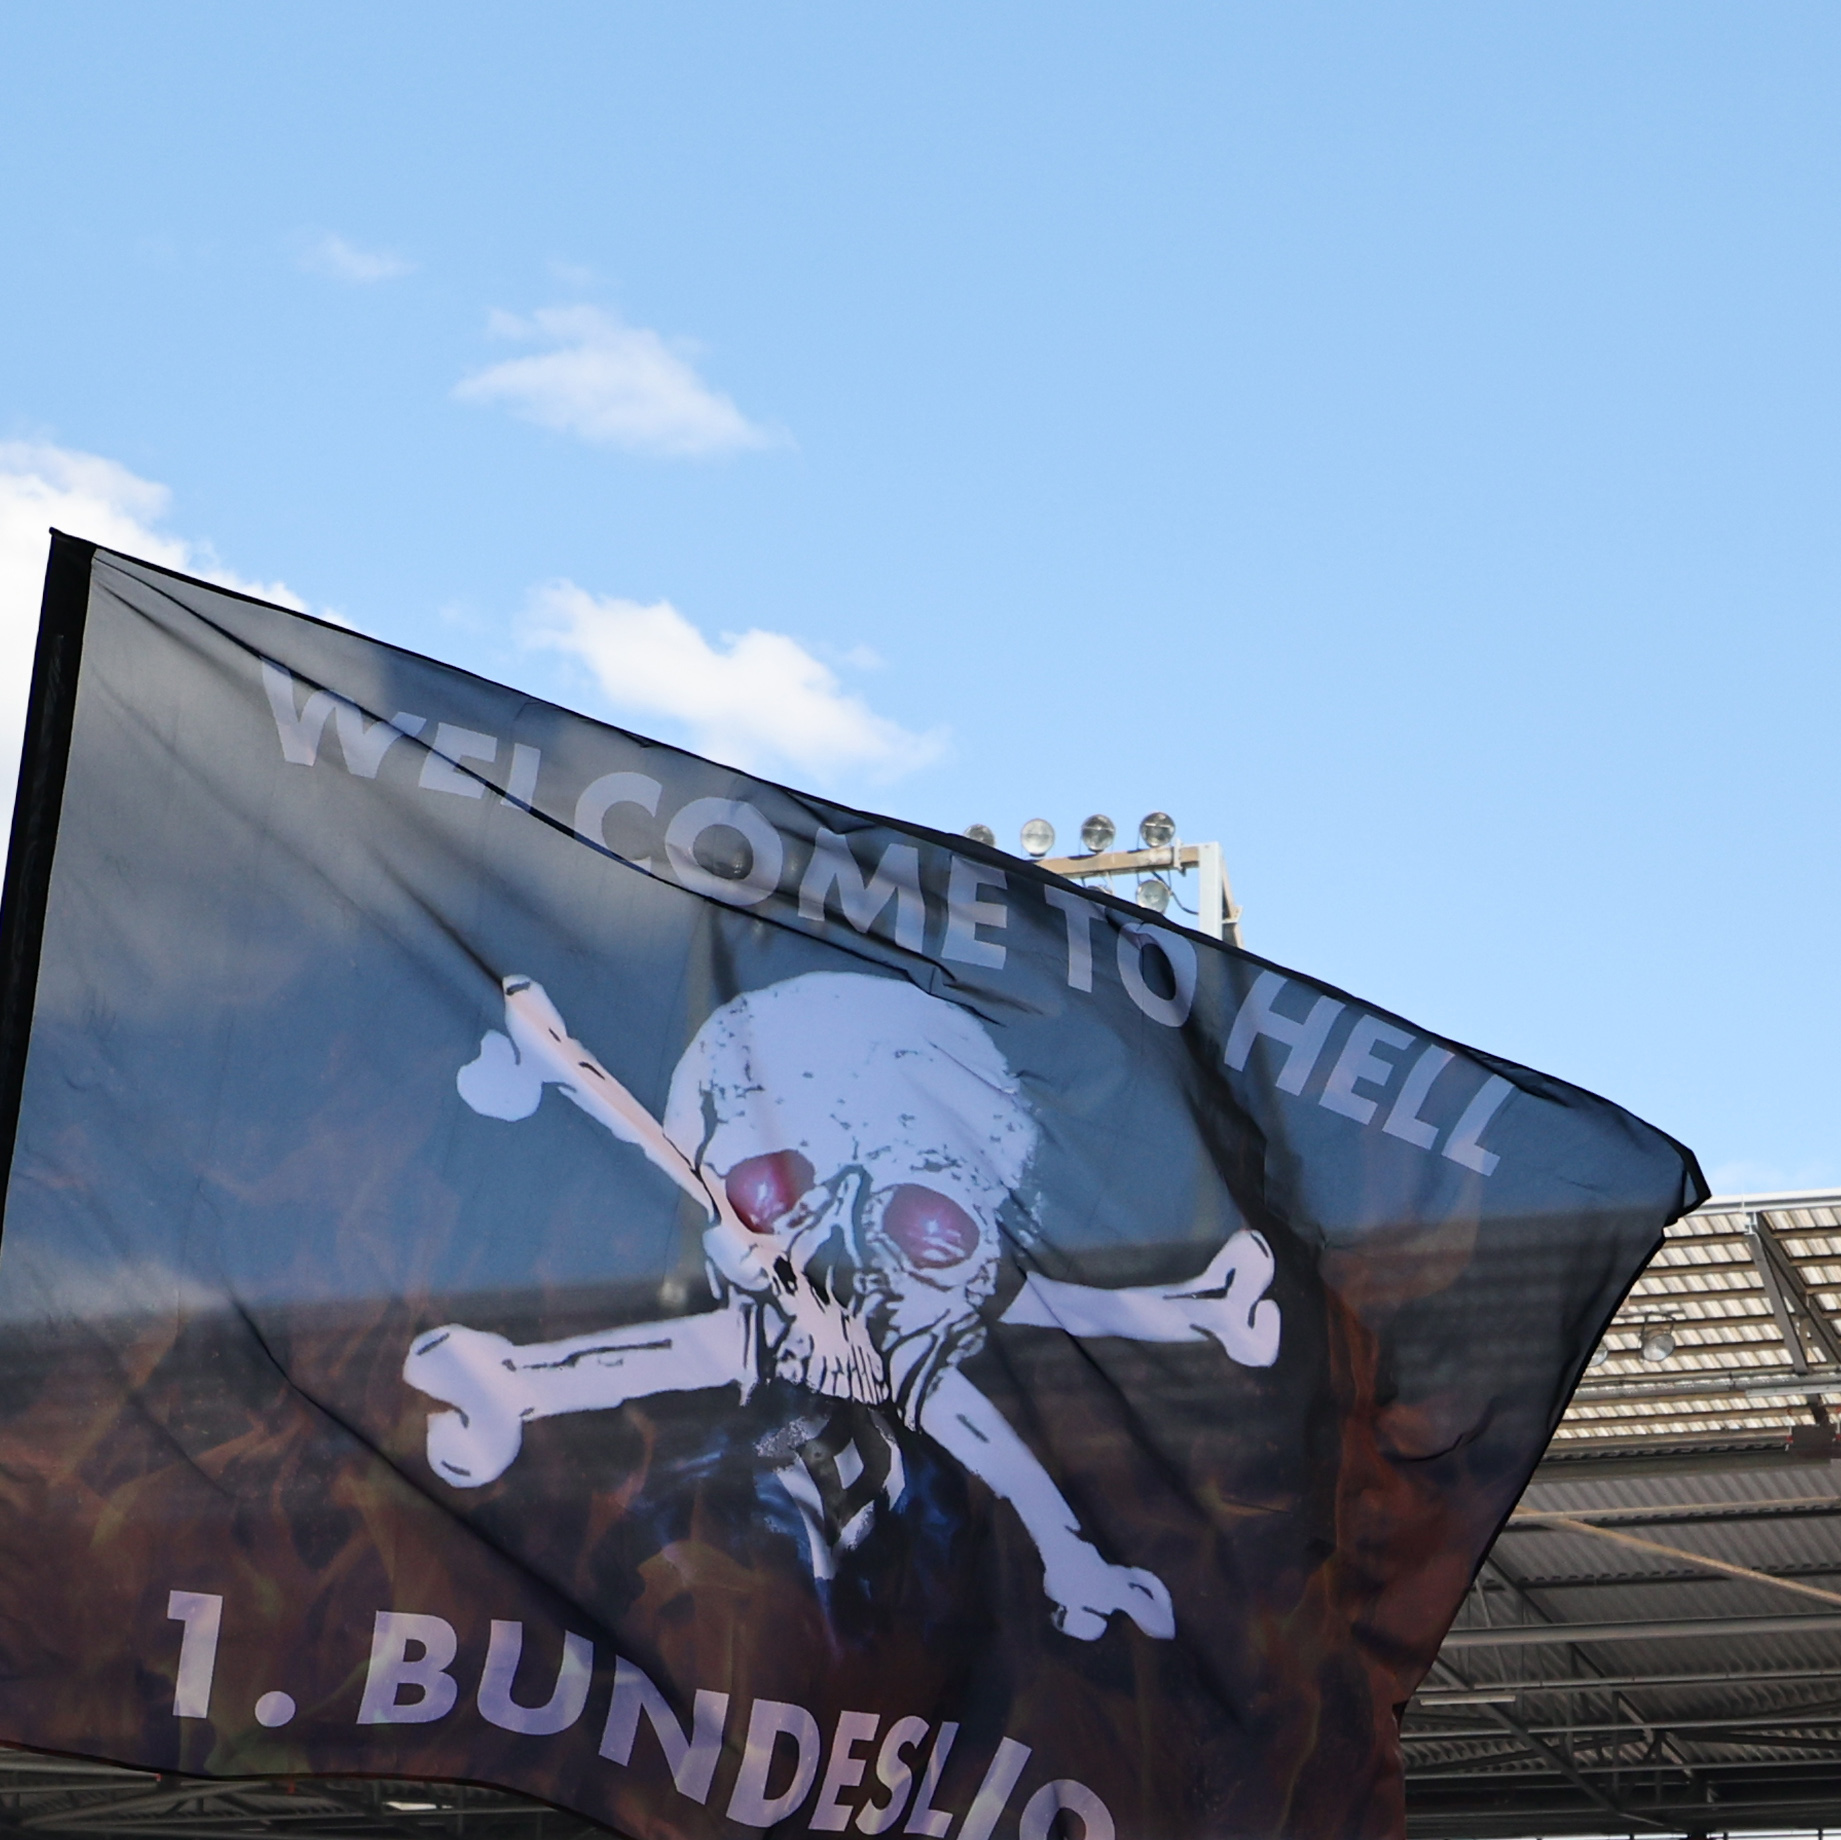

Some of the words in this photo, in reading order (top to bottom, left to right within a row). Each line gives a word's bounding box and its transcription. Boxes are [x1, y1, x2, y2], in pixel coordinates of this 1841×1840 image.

[261, 656, 1009, 970] WELCOME
[1044, 884, 1198, 1028] TO
[1224, 969, 1518, 1177] HELL
[166, 1590, 296, 1728] 1.
